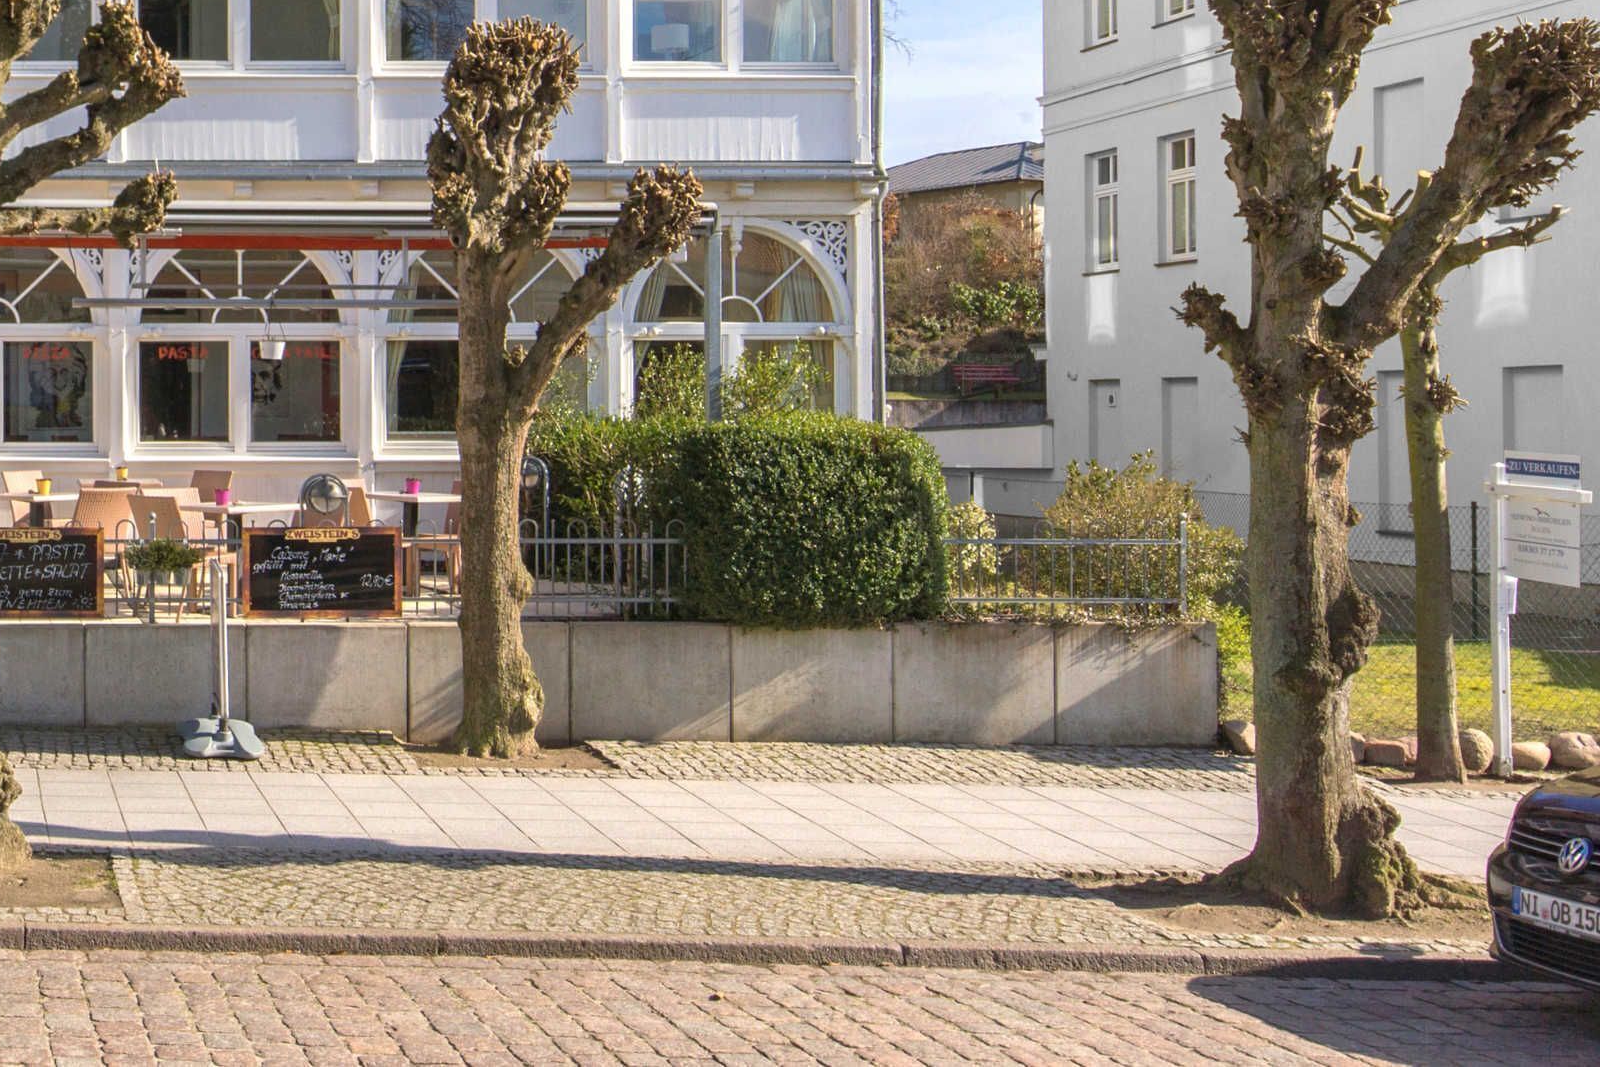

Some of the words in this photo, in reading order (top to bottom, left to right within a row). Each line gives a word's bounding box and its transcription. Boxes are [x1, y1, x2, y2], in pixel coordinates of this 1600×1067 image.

[158, 346, 208, 359] PASTA
[30, 543, 86, 562] PASTA
[1521, 893, 1539, 917] NI
